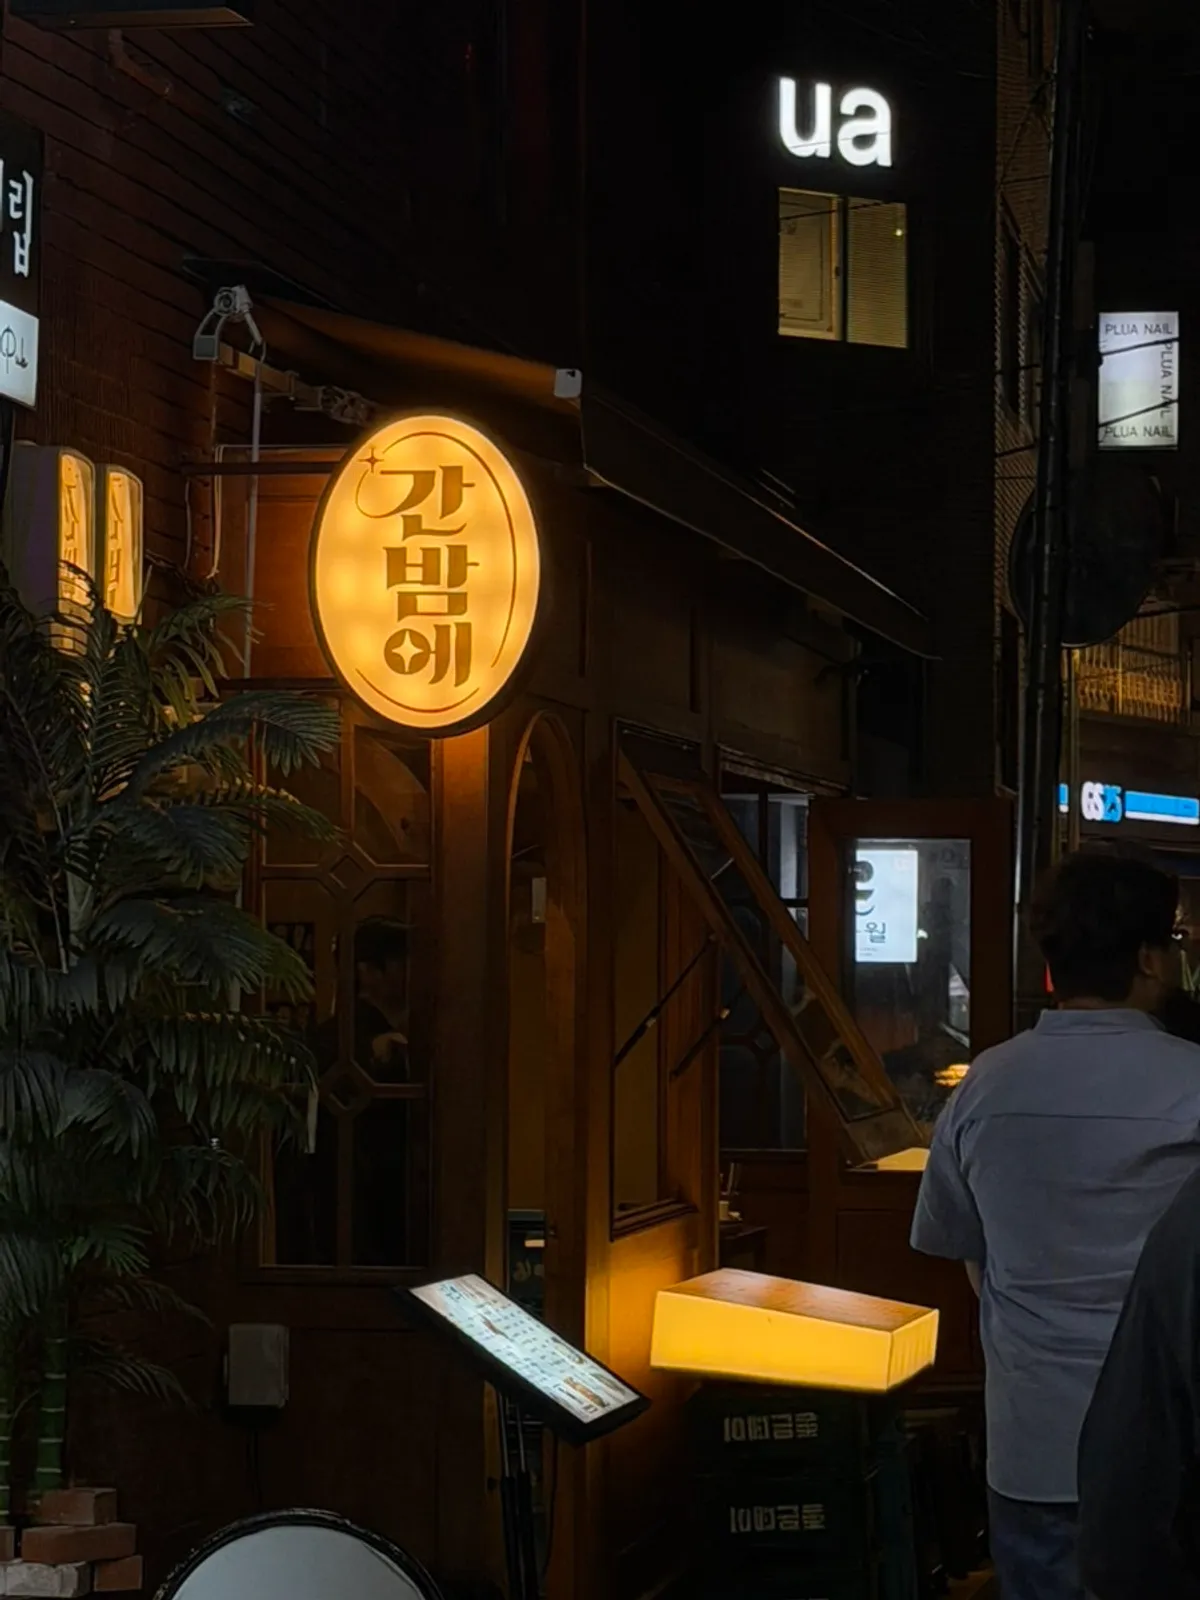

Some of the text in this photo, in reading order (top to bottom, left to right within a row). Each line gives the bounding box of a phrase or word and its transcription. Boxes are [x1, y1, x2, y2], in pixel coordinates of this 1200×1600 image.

[779, 76, 892, 167] ua
[1105, 323, 1173, 336] PLUA NAIL
[1161, 341, 1174, 379] PLUA
[1105, 425, 1174, 438] PLUA NAIL
[357, 465, 479, 687] 간밤에
